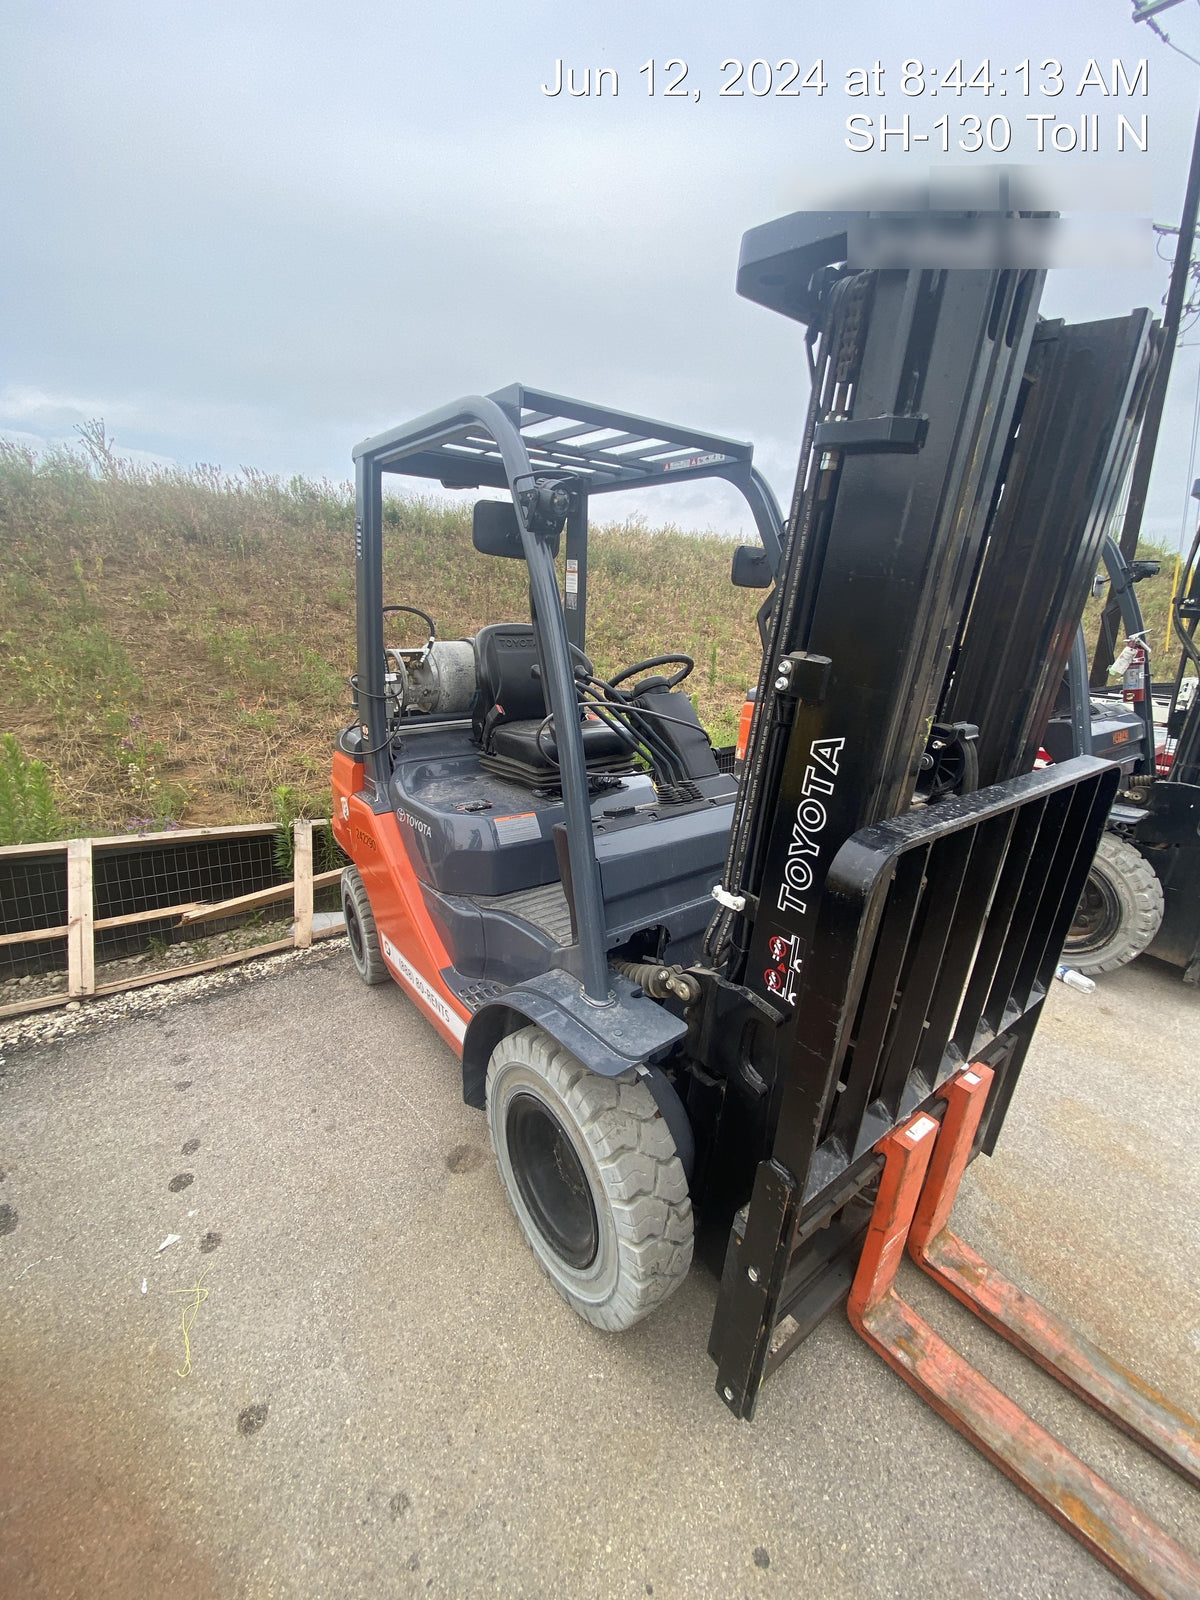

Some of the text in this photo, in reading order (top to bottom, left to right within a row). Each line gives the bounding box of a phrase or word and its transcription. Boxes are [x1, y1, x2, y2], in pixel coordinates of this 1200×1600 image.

[499, 638, 536, 648] TOYOT
[405, 813, 432, 838] TOYOTA
[776, 736, 846, 915] TOYOTA
